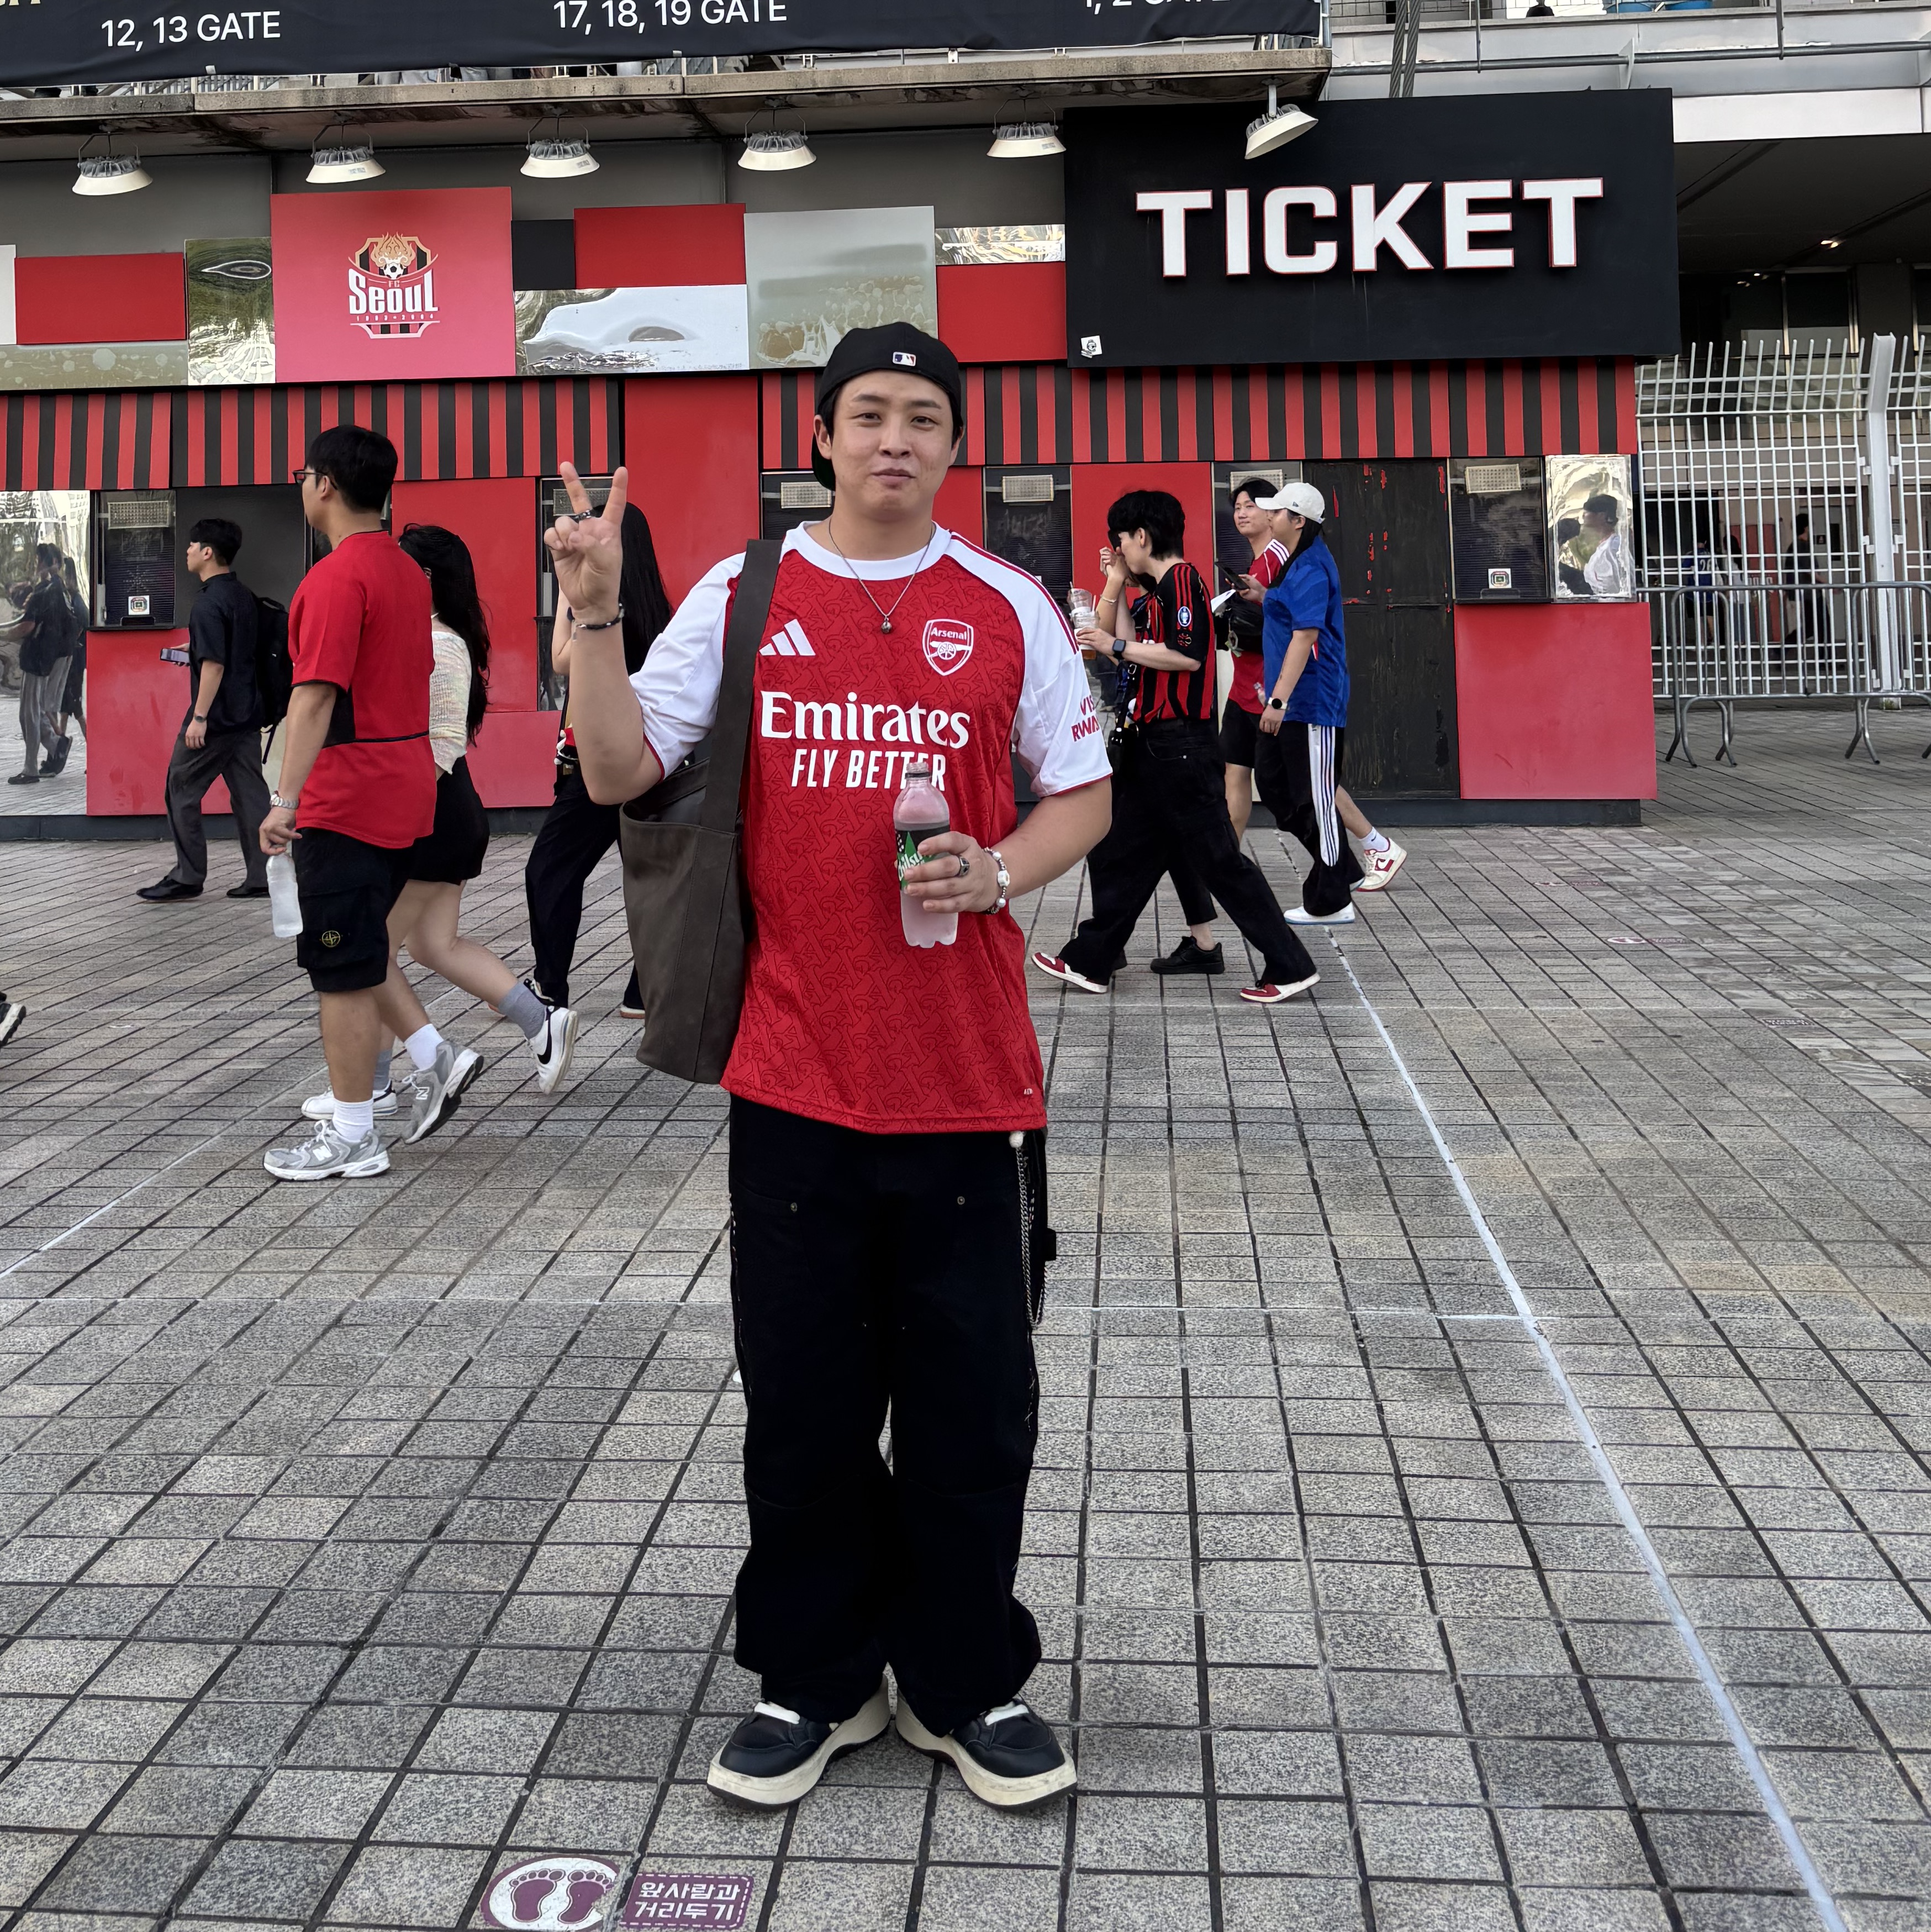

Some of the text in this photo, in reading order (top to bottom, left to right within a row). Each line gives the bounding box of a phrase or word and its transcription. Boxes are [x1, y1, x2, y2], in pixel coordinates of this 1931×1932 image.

[101, 10, 281, 52] 12, 13 GATE
[553, 0, 788, 35] 17, 18, 19 GATE
[1135, 177, 1605, 278] TICKET
[931, 627, 967, 640] Arsenal
[761, 689, 970, 749] Emirates
[791, 749, 946, 792] FLY BETTR
[639, 1881, 741, 1901] 앞사람과
[635, 1901, 735, 1922] 거리두기
